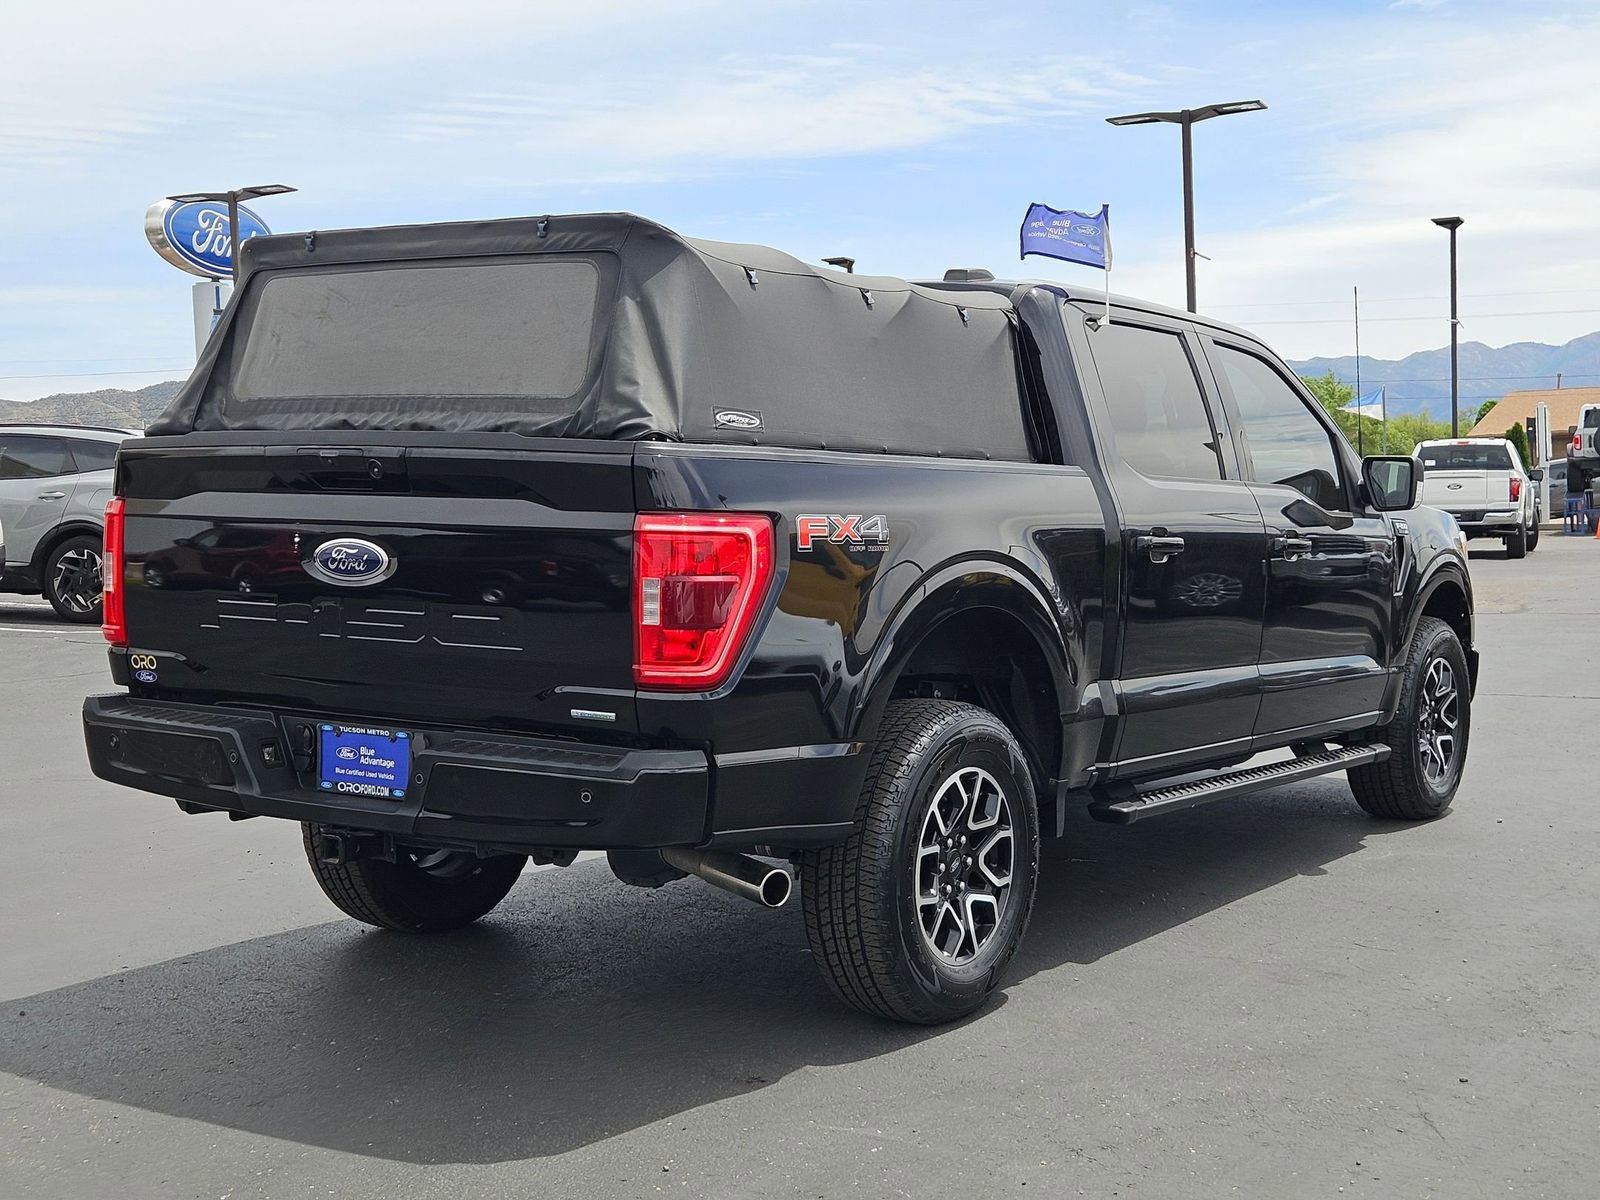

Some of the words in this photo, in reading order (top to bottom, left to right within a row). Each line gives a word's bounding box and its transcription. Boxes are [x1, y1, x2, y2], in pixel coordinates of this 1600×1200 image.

[796, 514, 889, 552] FX4
[327, 546, 368, 571] Ford
[131, 654, 157, 670] ORO
[339, 725, 366, 735] TUCSON
[367, 728, 390, 737] METRO
[360, 746, 375, 756] Blue
[360, 756, 395, 768] Advantage
[335, 766, 346, 774] Blue
[346, 768, 365, 777] Certified
[365, 770, 378, 778] Used
[378, 772, 395, 780] Vehicle
